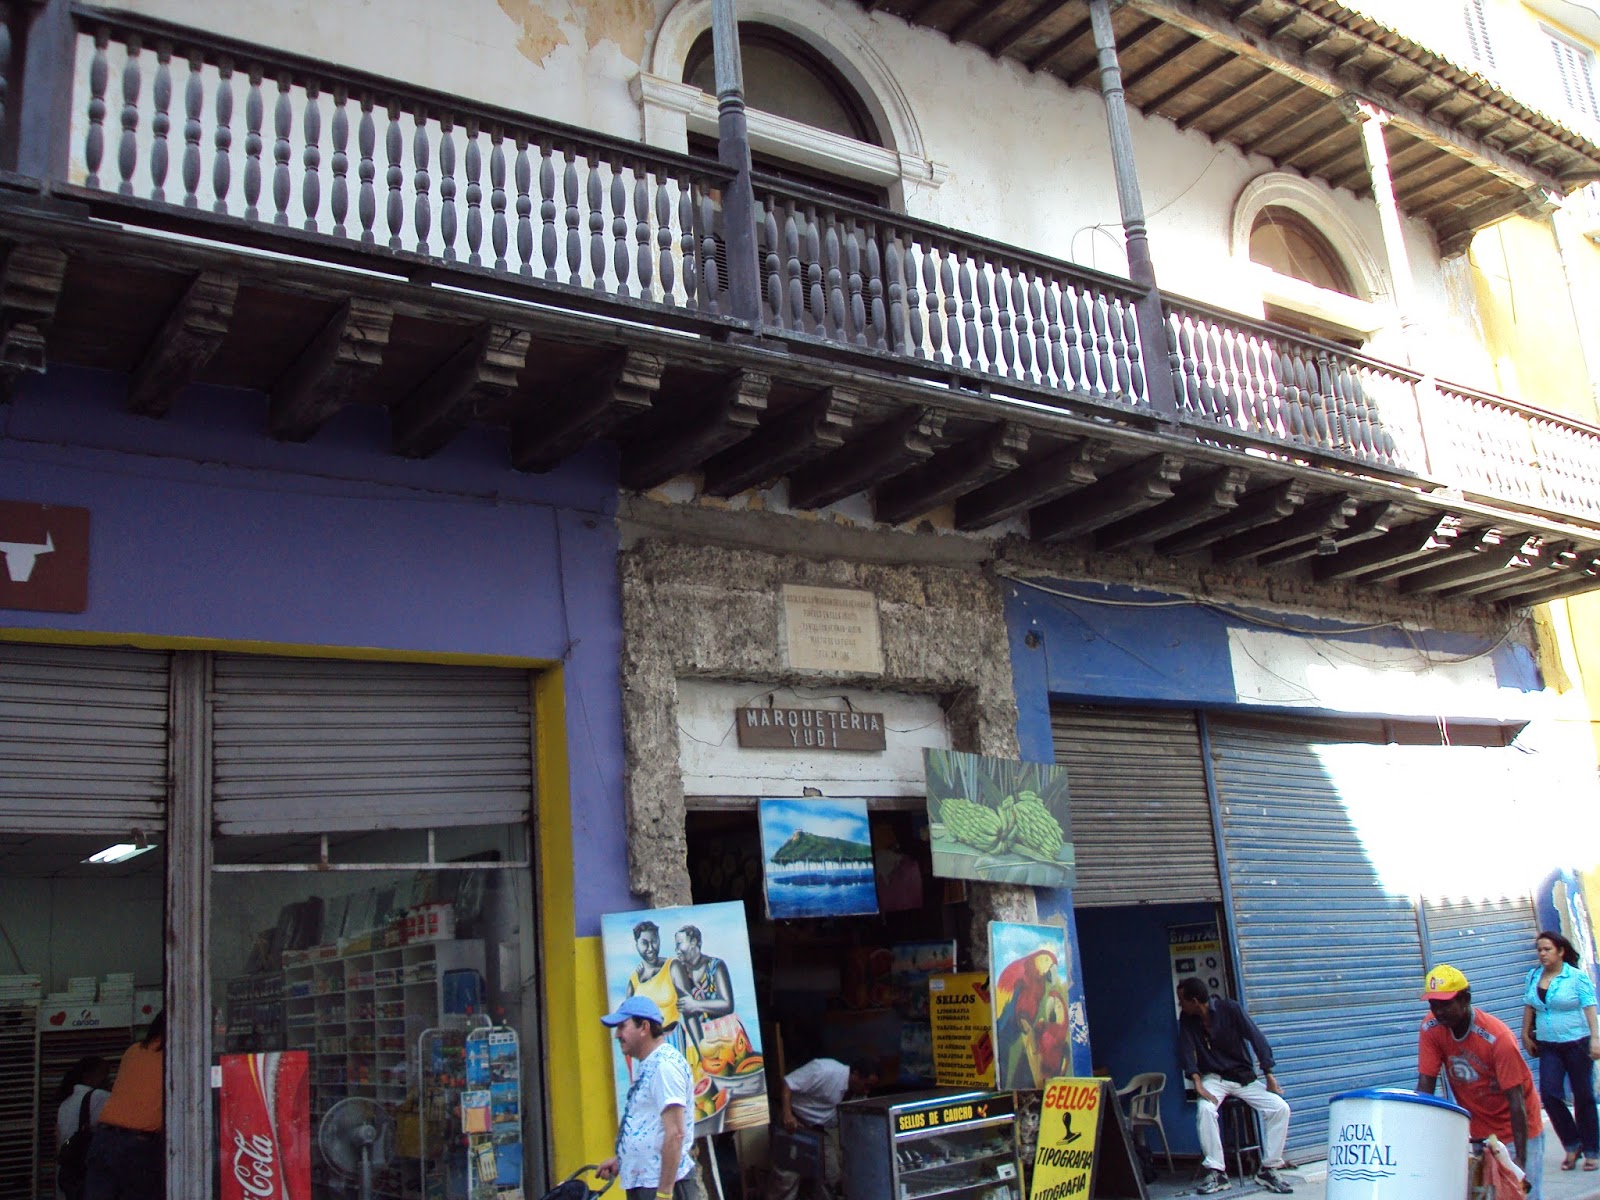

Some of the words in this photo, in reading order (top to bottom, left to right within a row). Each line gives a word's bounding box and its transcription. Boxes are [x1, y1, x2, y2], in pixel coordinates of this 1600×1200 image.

[746, 709, 880, 731] MARQUETERIA
[790, 729, 838, 748] YUDI
[936, 994, 976, 1005] SELLOS
[1045, 1085, 1099, 1111] SELLOS
[899, 1113, 925, 1130] SELLOS
[929, 1111, 939, 1125] DE
[943, 1105, 973, 1123] CAUCHO
[1338, 1124, 1375, 1142] AGUA
[1037, 1147, 1093, 1170] TIPOGRAFIA
[1329, 1143, 1397, 1166] CRISTAL
